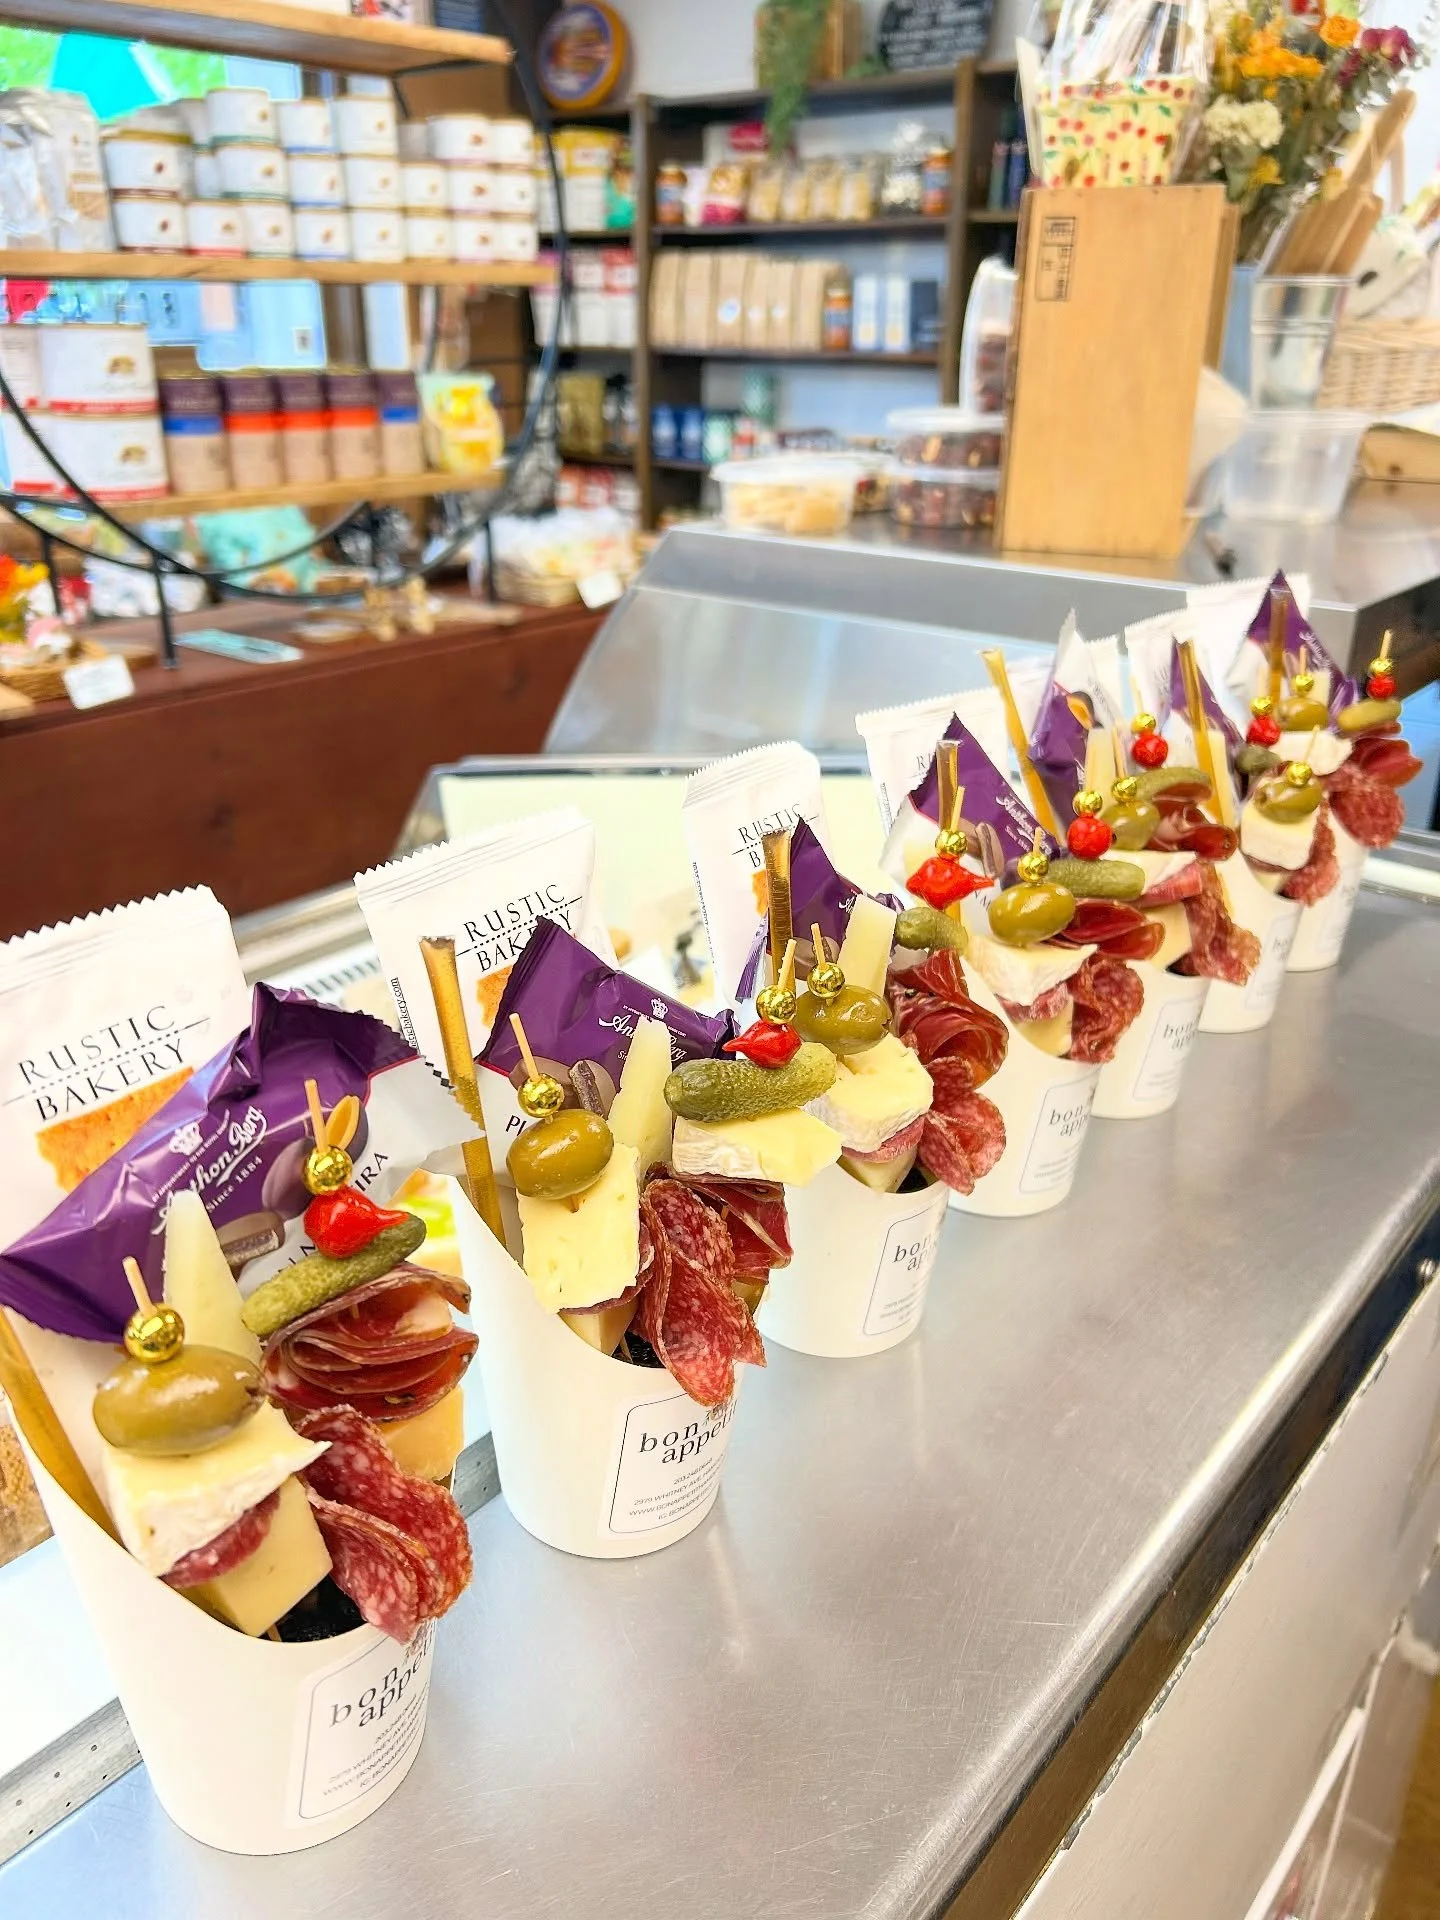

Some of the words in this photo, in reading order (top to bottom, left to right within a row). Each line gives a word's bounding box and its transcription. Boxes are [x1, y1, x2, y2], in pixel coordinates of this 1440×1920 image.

[737, 803, 806, 844] RUSTIC
[463, 884, 565, 942] RUSTIC
[476, 909, 571, 972] BAKY
[18, 1005, 175, 1085] RUSTIC
[36, 1038, 184, 1121] BAKERY
[151, 1150, 233, 1236] Athon
[205, 1185, 235, 1214] Since
[235, 1154, 263, 1184] 1884
[638, 1422, 699, 1453] bon
[329, 1667, 398, 1728] bon
